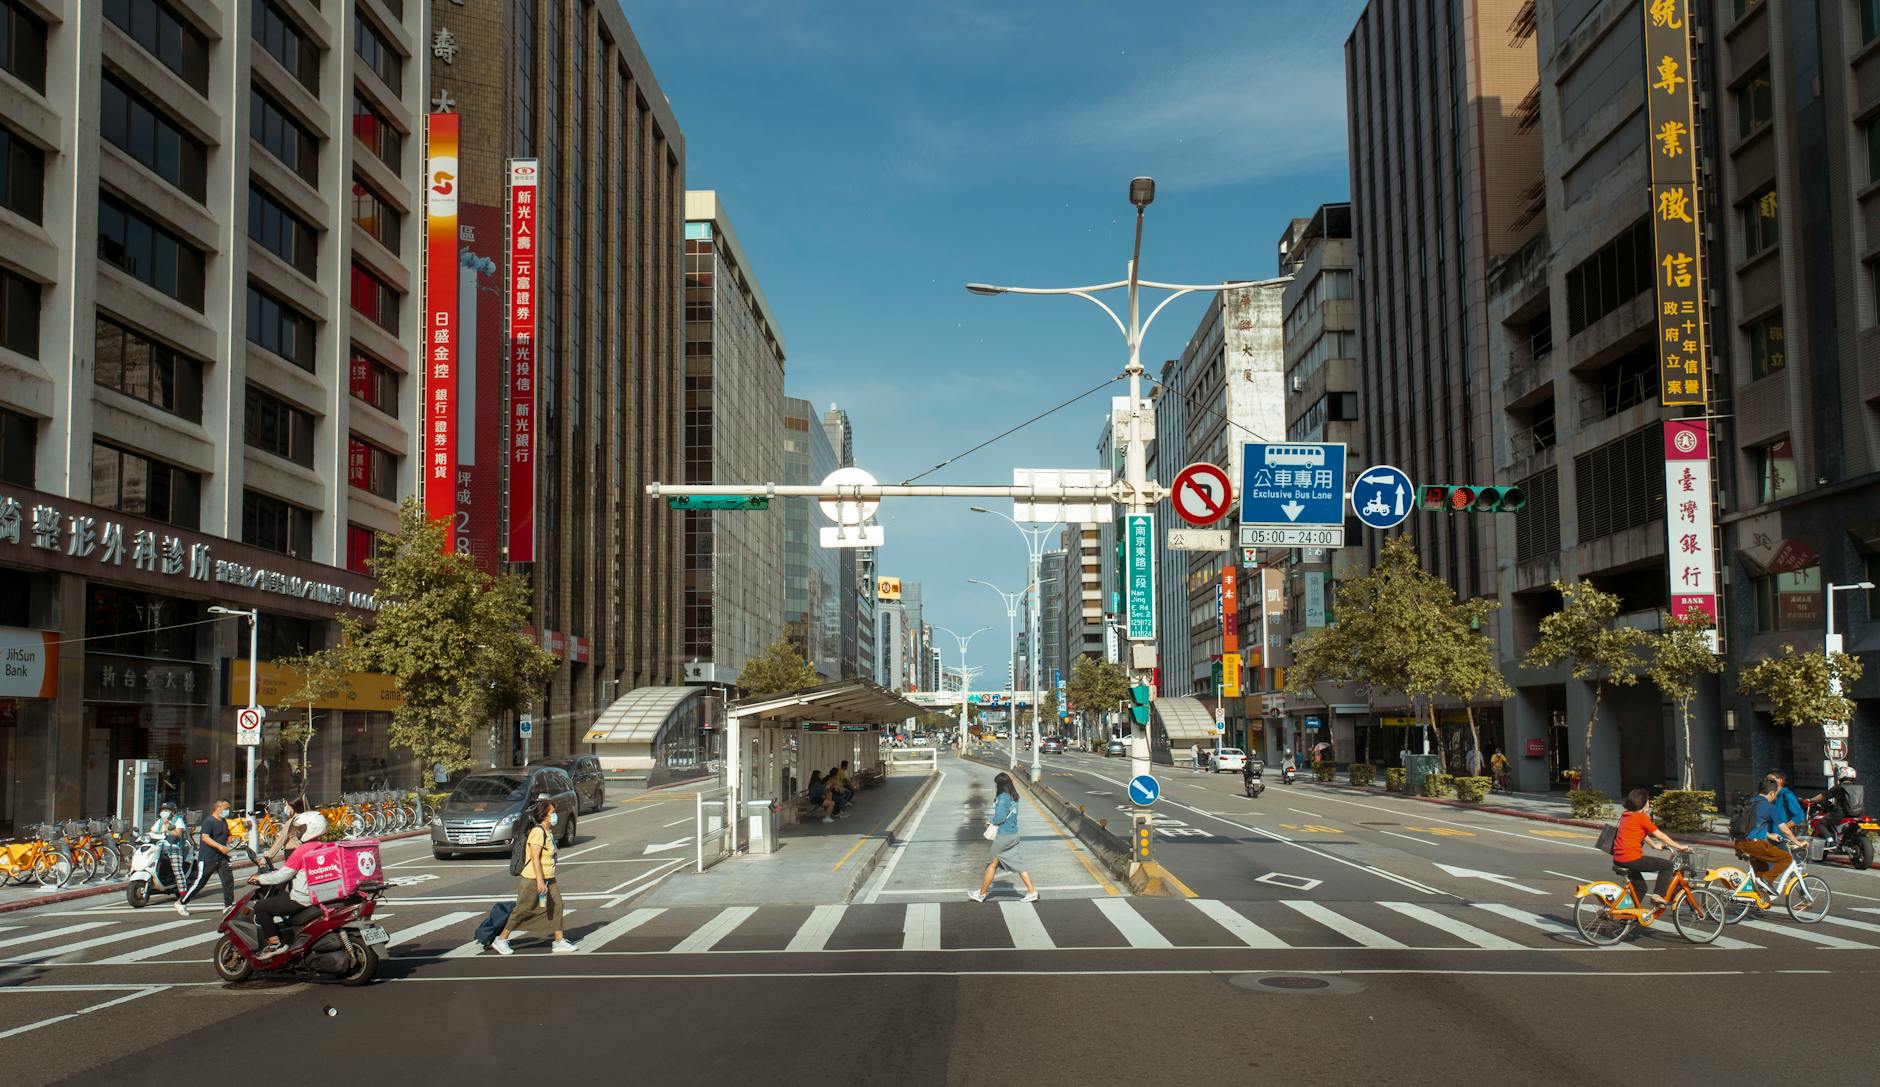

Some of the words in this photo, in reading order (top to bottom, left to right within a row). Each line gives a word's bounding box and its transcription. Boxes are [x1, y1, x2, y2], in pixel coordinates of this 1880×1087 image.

[517, 191, 531, 249] 新光人壽
[516, 261, 531, 320] 元富證券
[434, 312, 450, 379] 日盛金控
[516, 332, 530, 391] 新光投信
[1664, 301, 1682, 395] 政府立案
[1681, 301, 1699, 394] 三十年信譽
[515, 404, 529, 463] 新光銀行
[1253, 489, 1292, 499] Exclusive
[1295, 489, 1310, 499] Bus
[1312, 490, 1332, 500] Lane
[1254, 468, 1333, 489] 公車專用
[1252, 530, 1285, 543] 05:00
[1298, 531, 1332, 544] 24:00
[1678, 467, 1702, 587] 臺灣銀行
[1135, 526, 1147, 588] 南京東路二段
[5, 647, 35, 662] JihSun
[5, 664, 28, 677] Bank
[309, 864, 338, 875] foodpanda
